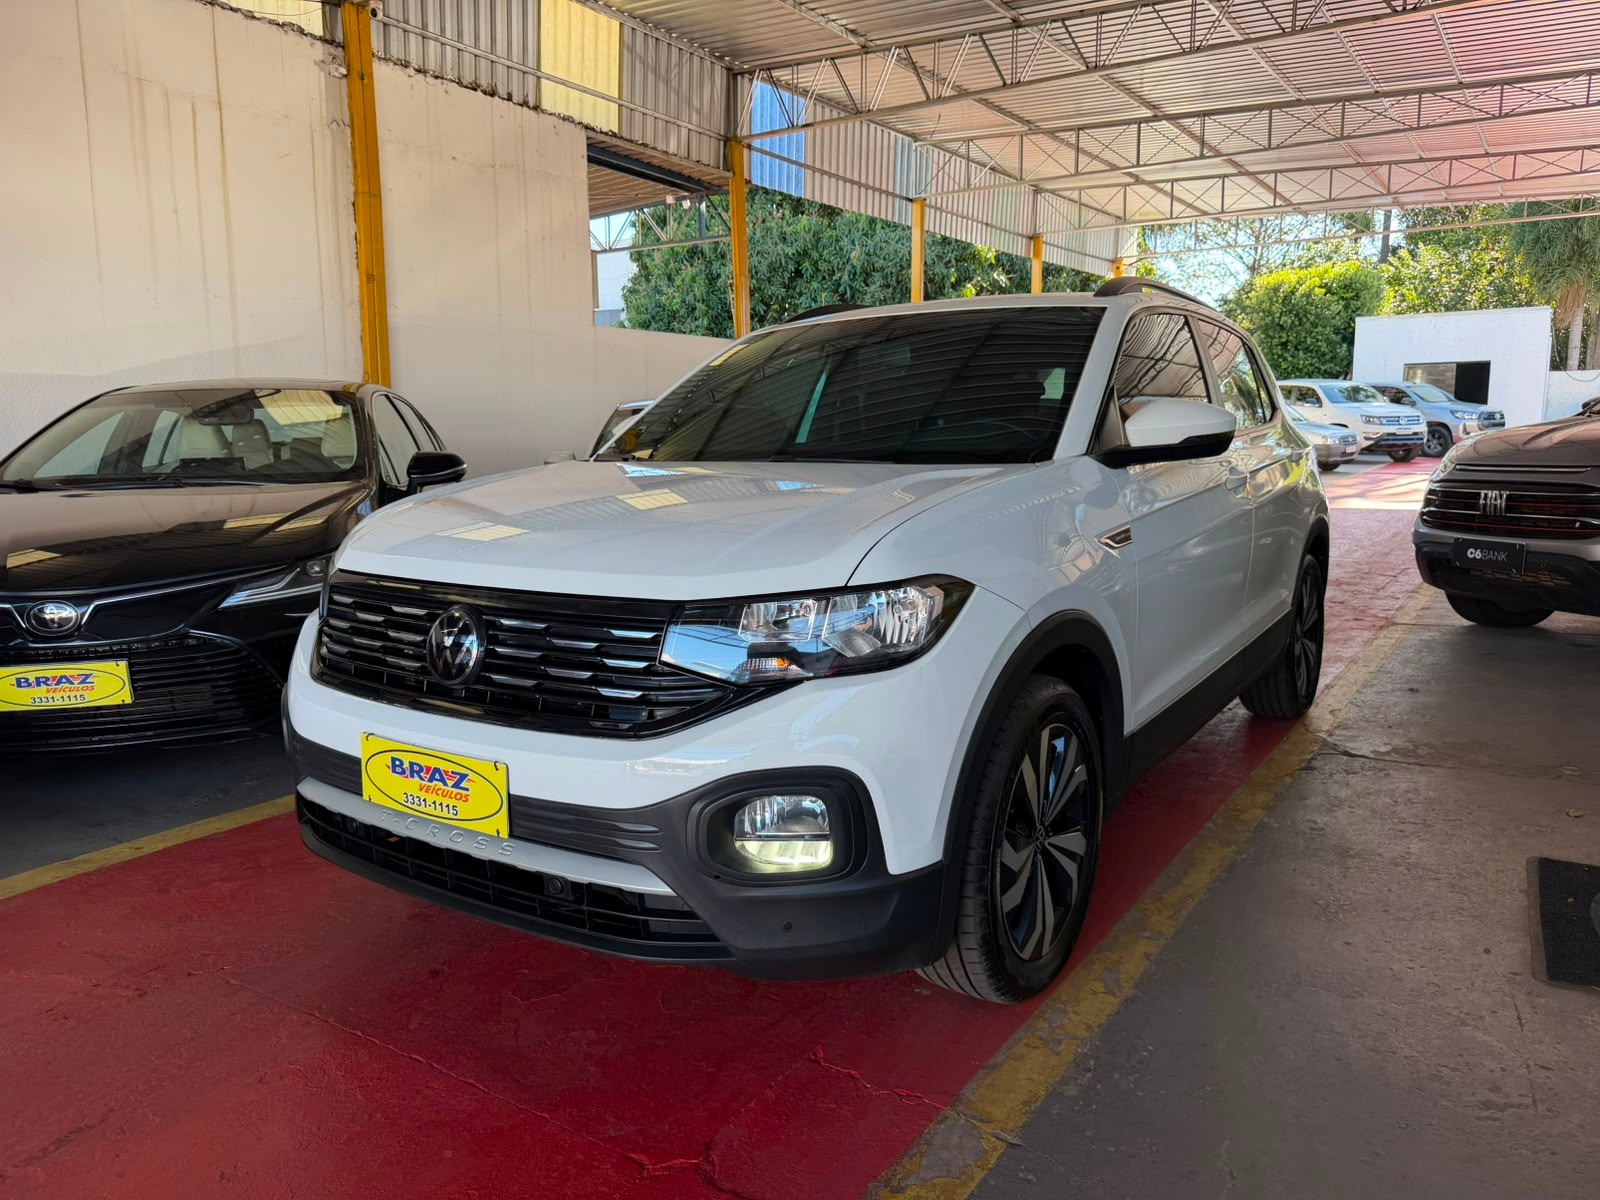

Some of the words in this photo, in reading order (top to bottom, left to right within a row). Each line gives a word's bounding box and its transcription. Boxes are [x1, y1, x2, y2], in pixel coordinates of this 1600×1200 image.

[1480, 490, 1509, 515] FIAT
[15, 673, 95, 689] BRAZ
[46, 685, 96, 694] VEÍCULOS
[30, 694, 86, 705] 3331-1115
[390, 756, 470, 792] BRAZ
[417, 782, 471, 803] VEÍCULOS
[402, 792, 459, 817] 3331-1115
[379, 809, 517, 856] T-CROSS
